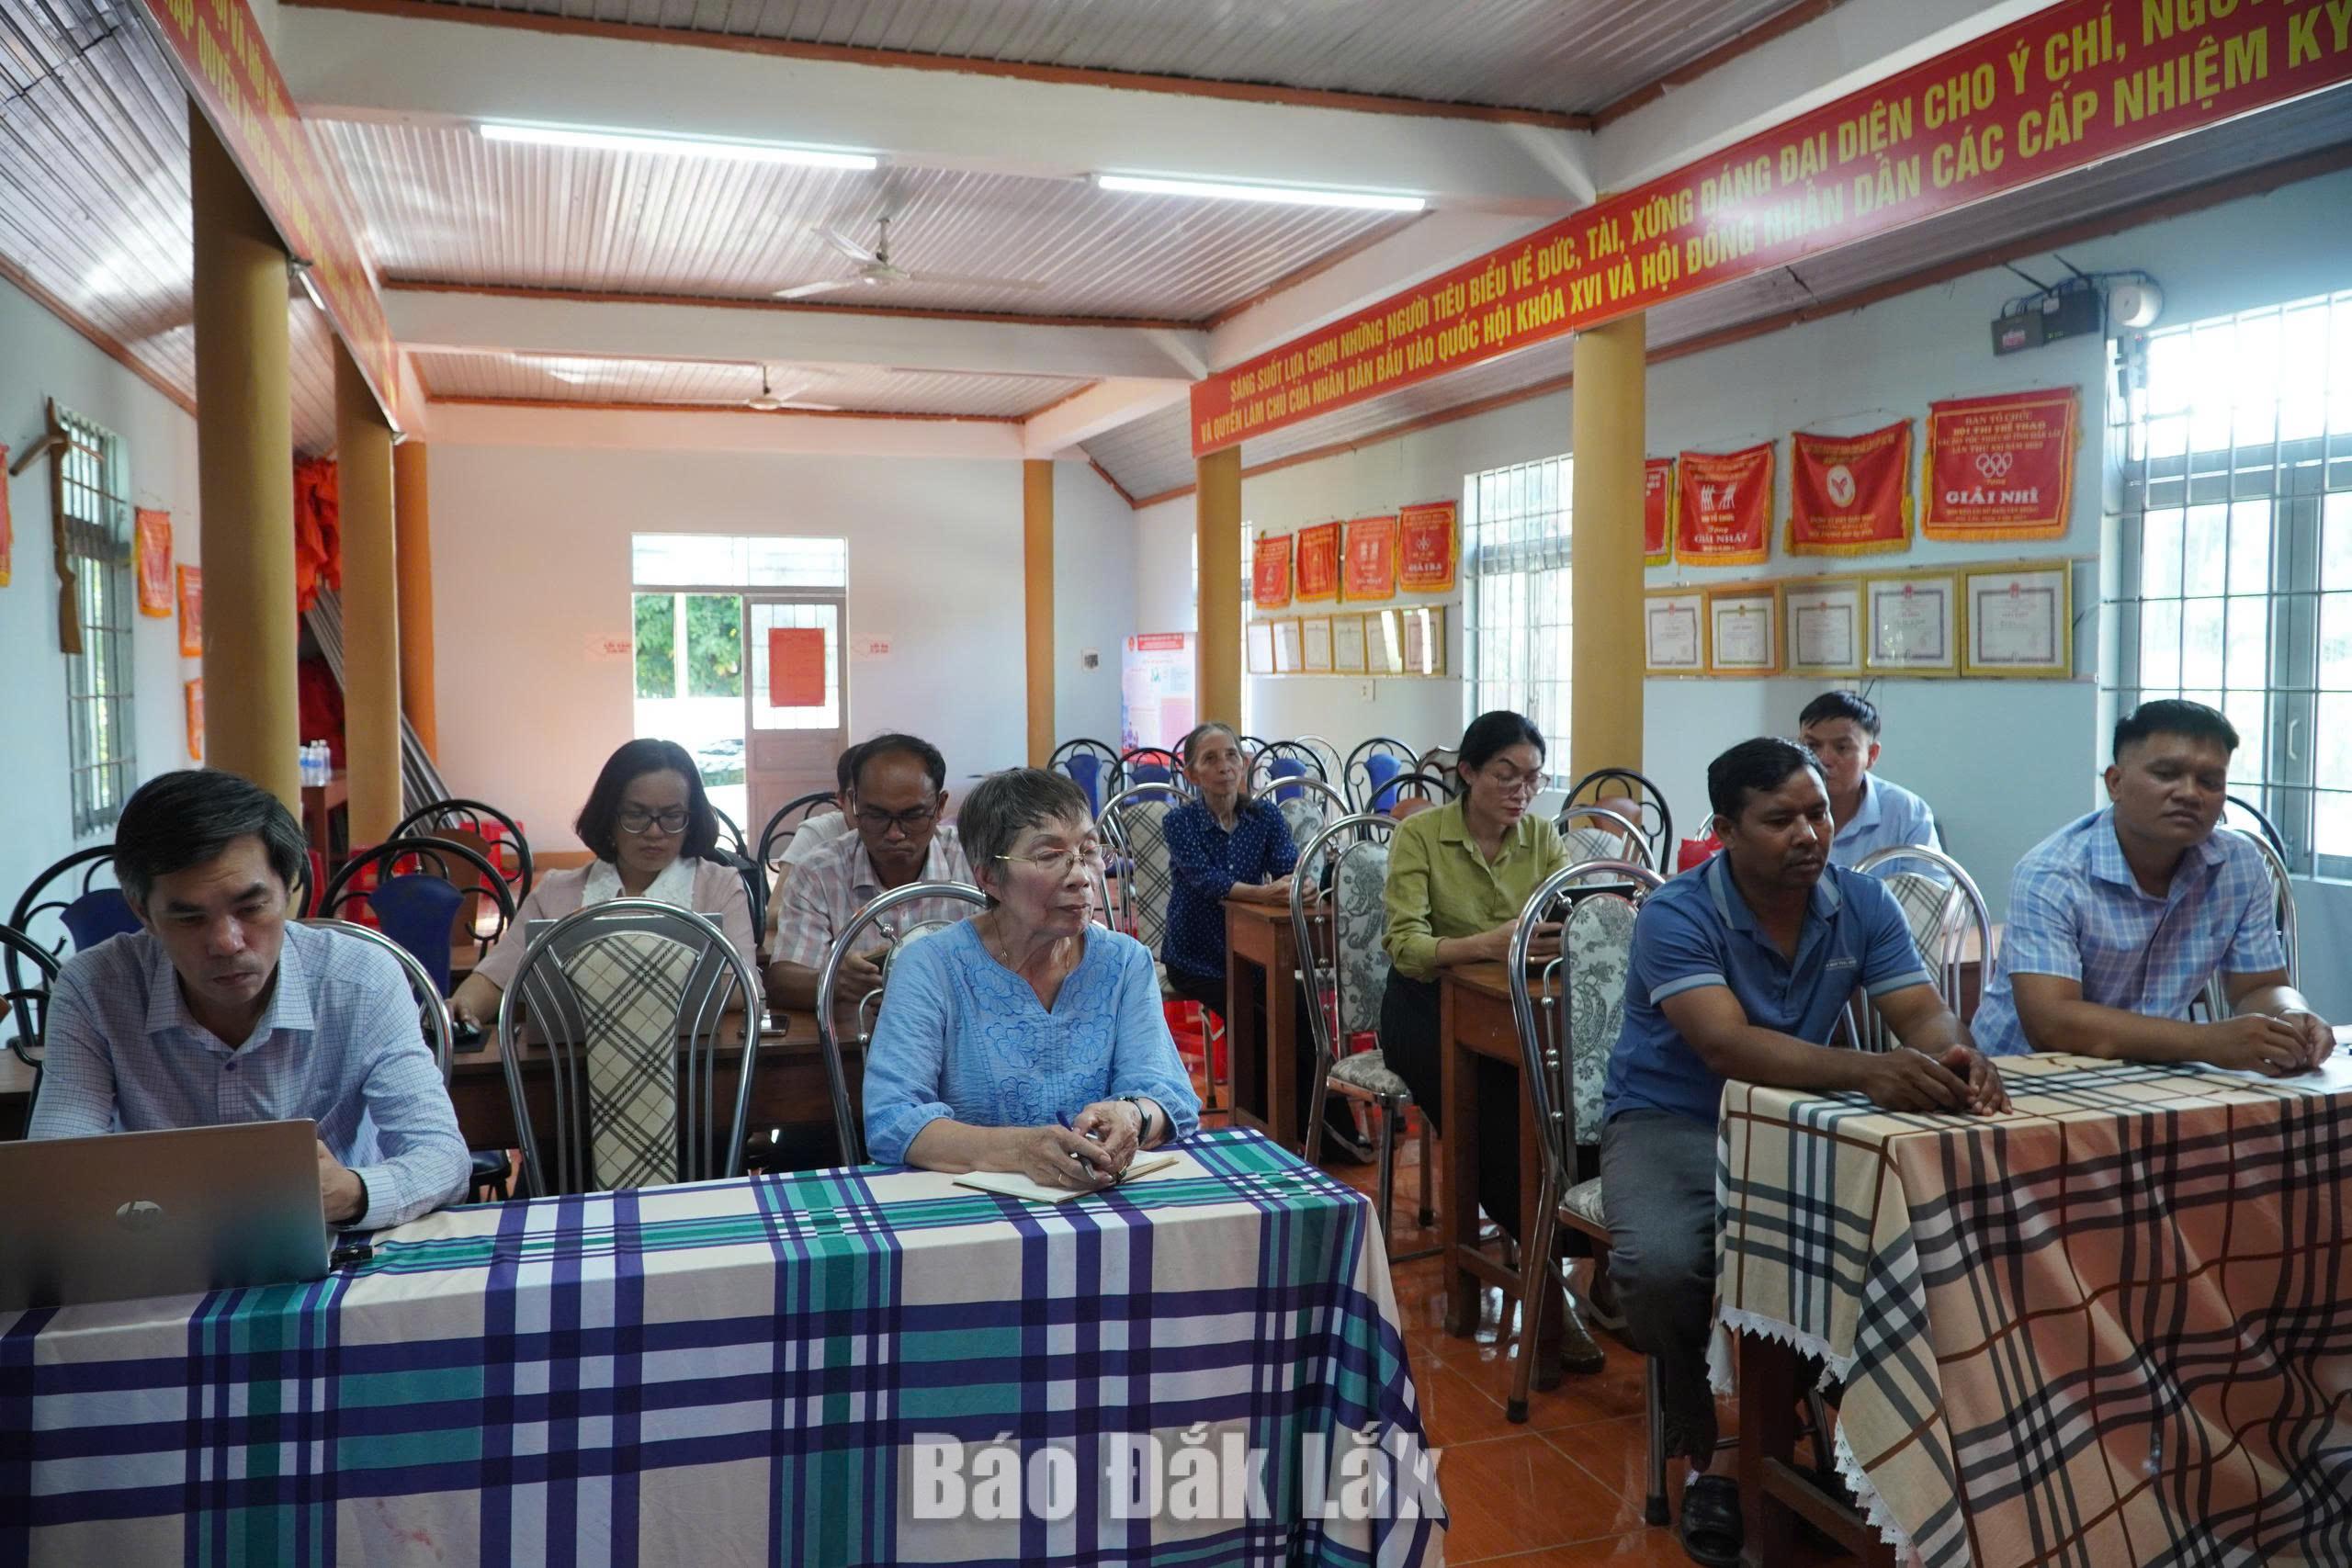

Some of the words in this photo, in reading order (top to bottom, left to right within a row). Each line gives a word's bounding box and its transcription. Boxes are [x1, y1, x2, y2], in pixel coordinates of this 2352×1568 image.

[1200, 419, 1212, 445] VÀ
[1214, 405, 1241, 441] QUYỀN
[1244, 400, 1264, 429] LÀM
[1266, 386, 1286, 422] CHỦ
[1289, 380, 1310, 413] CỦA
[1313, 368, 1344, 404] NHÂN
[1348, 357, 1374, 392] DÂN
[1377, 341, 1402, 382] BẦU
[1407, 334, 1434, 371] VÀO
[1438, 313, 1479, 362] QUỐC
[1484, 304, 1511, 346] HỘI
[1517, 286, 1566, 333] KHÓA
[1570, 272, 1601, 314] XVI
[1608, 255, 1636, 301] VÀ
[1642, 243, 1679, 291] HỘI
[1687, 211, 1757, 275] ĐỒNG
[1763, 180, 1843, 243] NHÂN
[1854, 153, 1920, 217] DÂN
[1933, 124, 2004, 188] CÁC
[2018, 81, 2098, 158] CẤP
[2114, 27, 2268, 128] NHIỆM
[1230, 372, 1256, 402] SÁNG
[1258, 355, 1283, 392] SUỐT
[1285, 352, 1305, 384] LỰA
[1307, 338, 1338, 371] CHỌN
[1340, 319, 1384, 359] NHỮNG
[1387, 296, 1430, 340] NGƯỜI
[1432, 282, 1465, 321] TIÊU
[1470, 257, 1507, 308] BIỂU
[1511, 243, 1532, 290] VỀ
[1537, 236, 1582, 281] ĐỨC,
[1587, 216, 1625, 262] TÀI,
[1632, 187, 1693, 246] XỨNG
[1701, 155, 1771, 217] ĐÁNG
[1781, 132, 1827, 186] ĐẠI
[1838, 96, 1913, 164] DIỆN
[1924, 62, 1996, 130] CHO
[2008, 39, 2030, 96] Ý
[2044, 5, 2127, 83] CHÍ,
[1946, 485, 1996, 504] GIẢI
